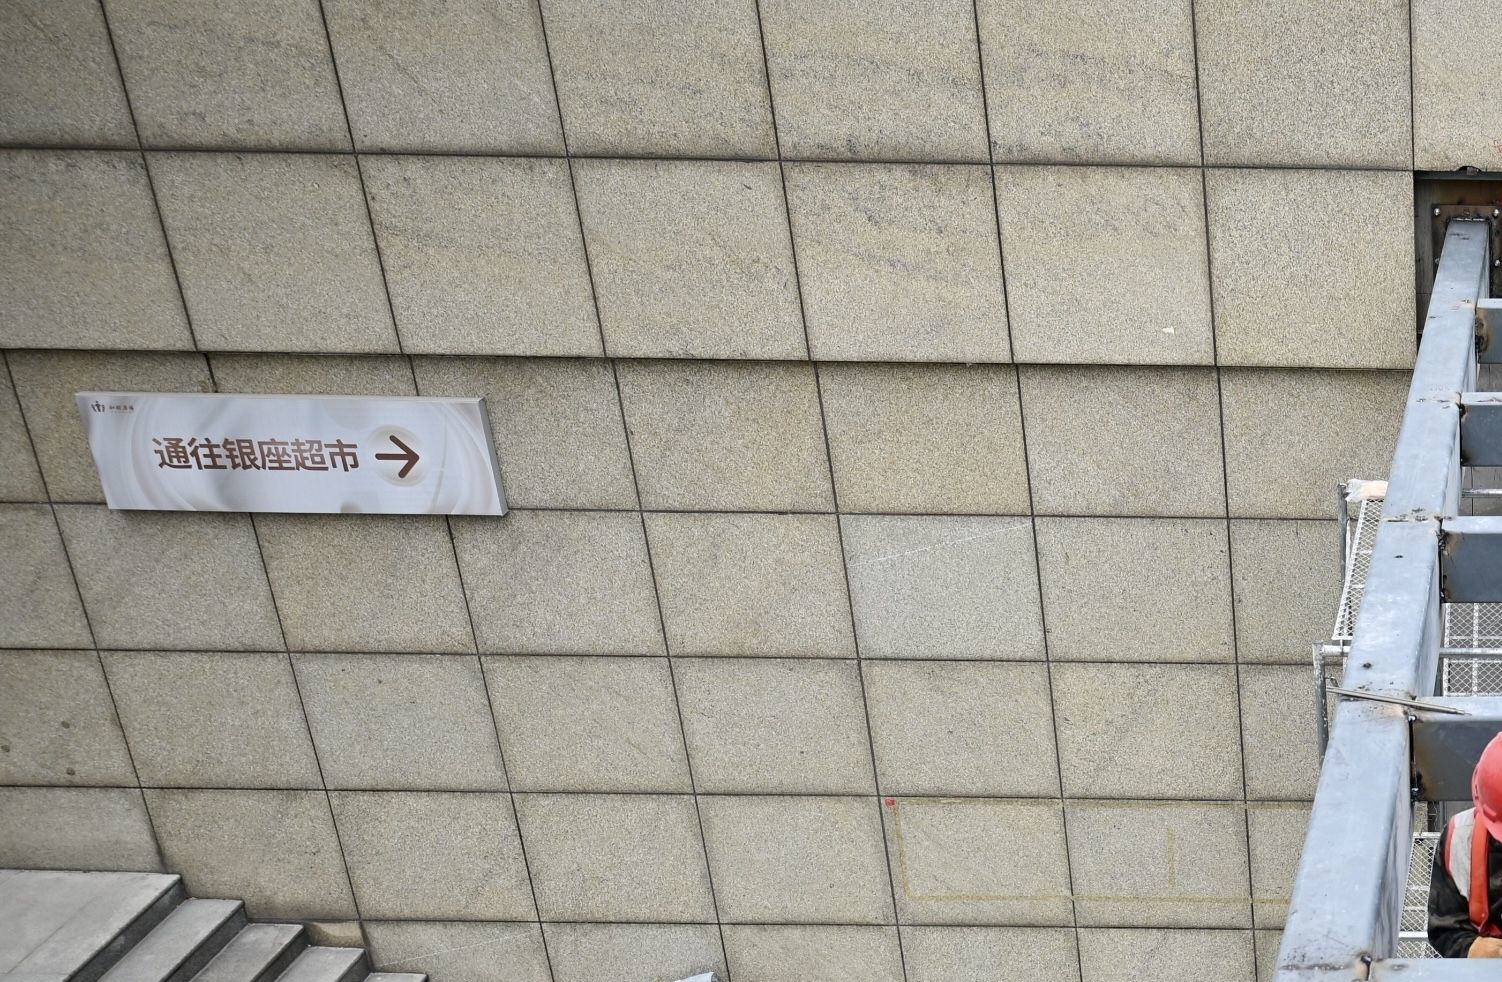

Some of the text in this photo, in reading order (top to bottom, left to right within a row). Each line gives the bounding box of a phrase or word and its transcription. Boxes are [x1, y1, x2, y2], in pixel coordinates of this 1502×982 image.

[152, 437, 360, 472] 通往银座超市
